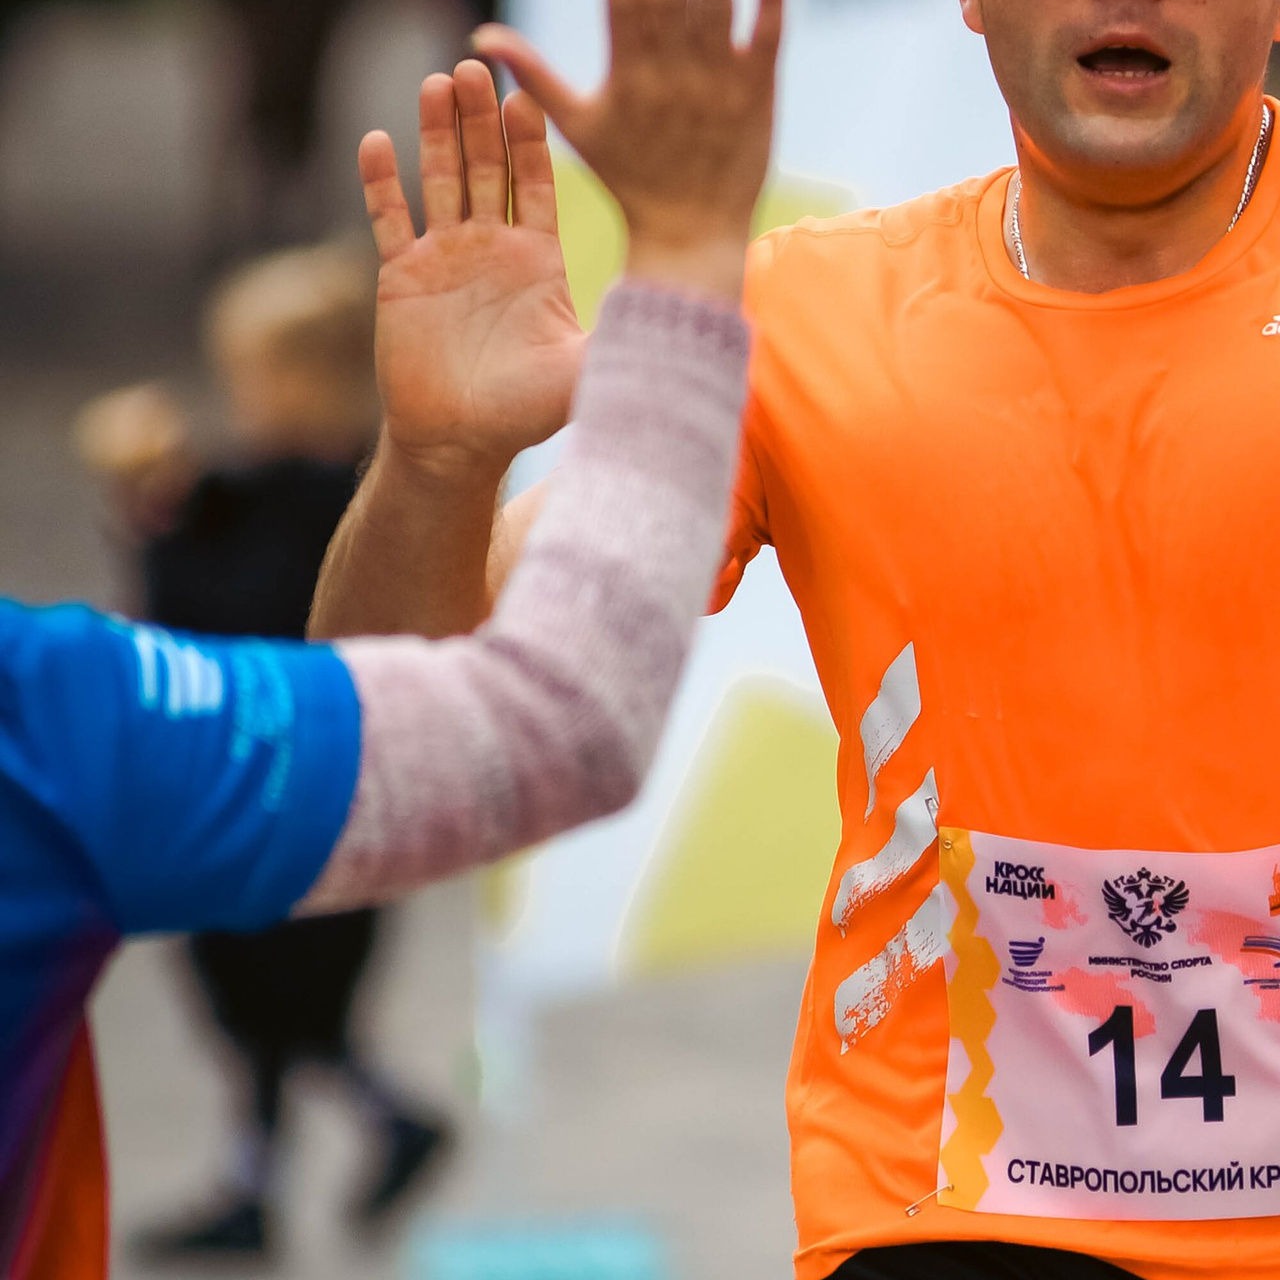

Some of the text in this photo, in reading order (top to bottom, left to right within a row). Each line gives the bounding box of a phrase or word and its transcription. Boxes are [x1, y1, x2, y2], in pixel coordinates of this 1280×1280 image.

[994, 860, 1046, 882] КРОСС
[985, 876, 1056, 900] НАЦИИ
[1088, 956, 1213, 971] МИНИСТЕРСТВО СПОРТА
[1130, 969, 1172, 983] РОССИИ
[1088, 1004, 1236, 1126] 14
[1007, 1159, 1244, 1194] СТАВРОПОЛЬСКИЙ
